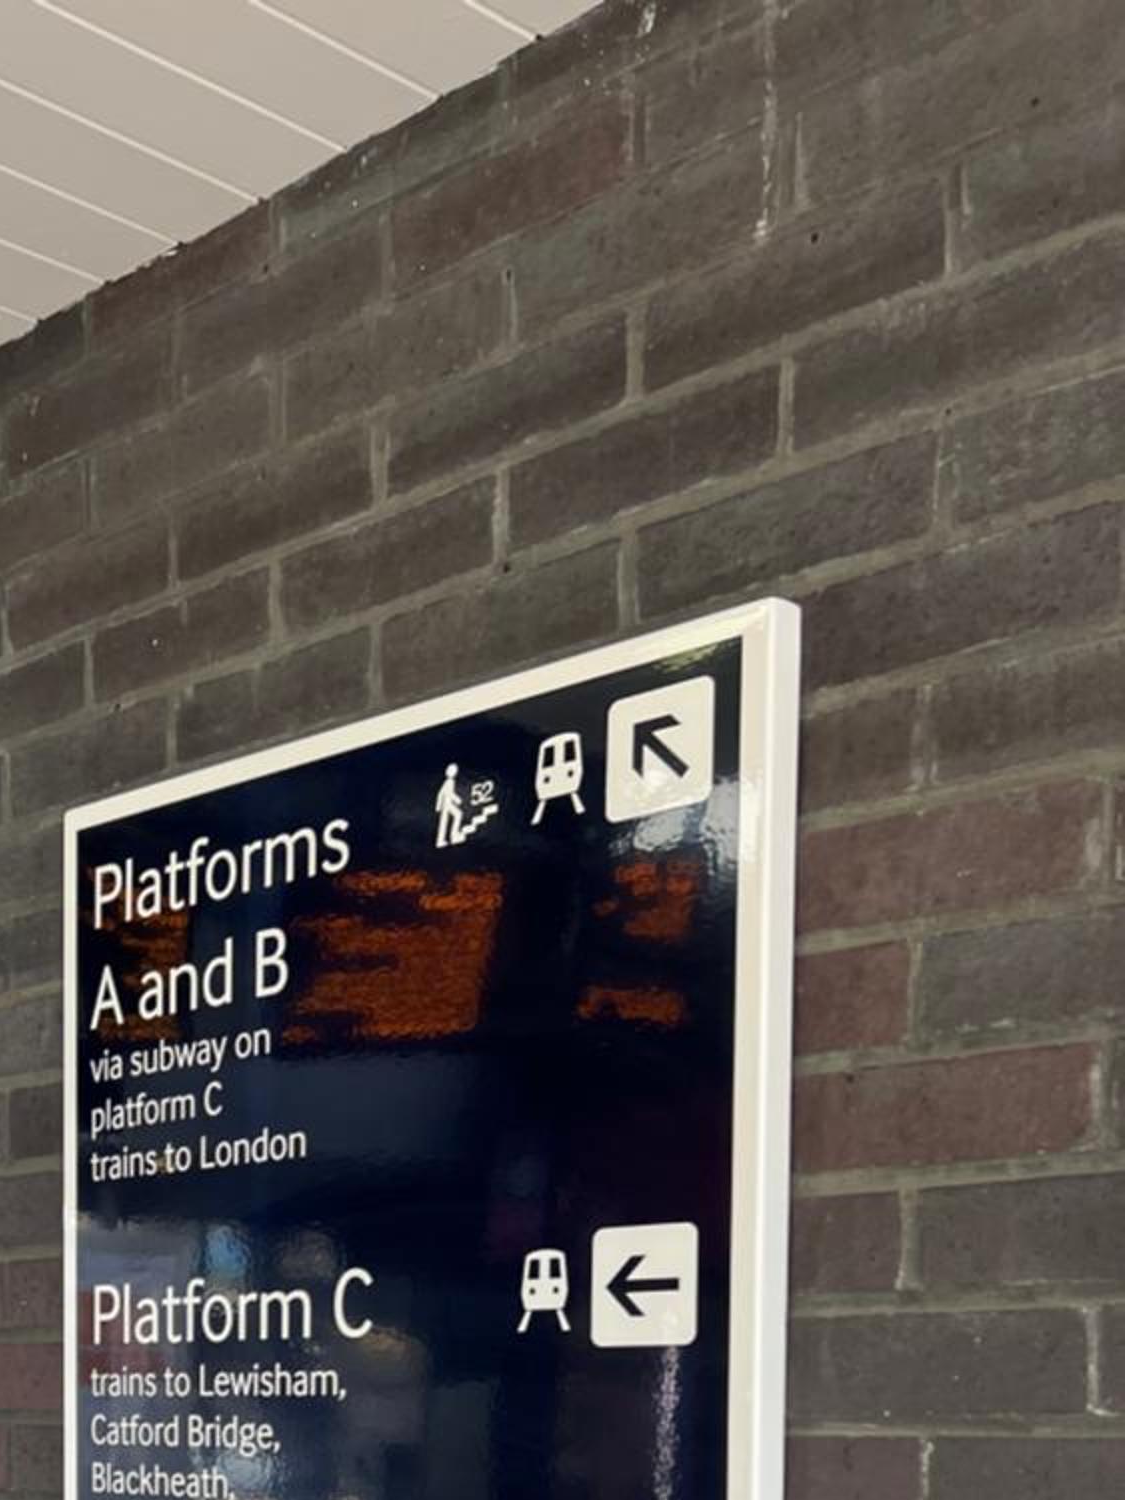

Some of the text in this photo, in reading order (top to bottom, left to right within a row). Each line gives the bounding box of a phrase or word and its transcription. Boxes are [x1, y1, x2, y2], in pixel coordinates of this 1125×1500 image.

[470, 780, 495, 806] 52
[92, 818, 351, 931] Platforms
[90, 927, 289, 1031] A and B
[90, 1027, 272, 1084] via subway on
[90, 1082, 224, 1141] platform C
[90, 1128, 308, 1183] trains to London
[91, 1266, 374, 1346] Platform C
[91, 1363, 347, 1401] trains to Lewisham,
[90, 1413, 281, 1458] Catford Bridge,
[91, 1461, 236, 1500] Blackheath,
